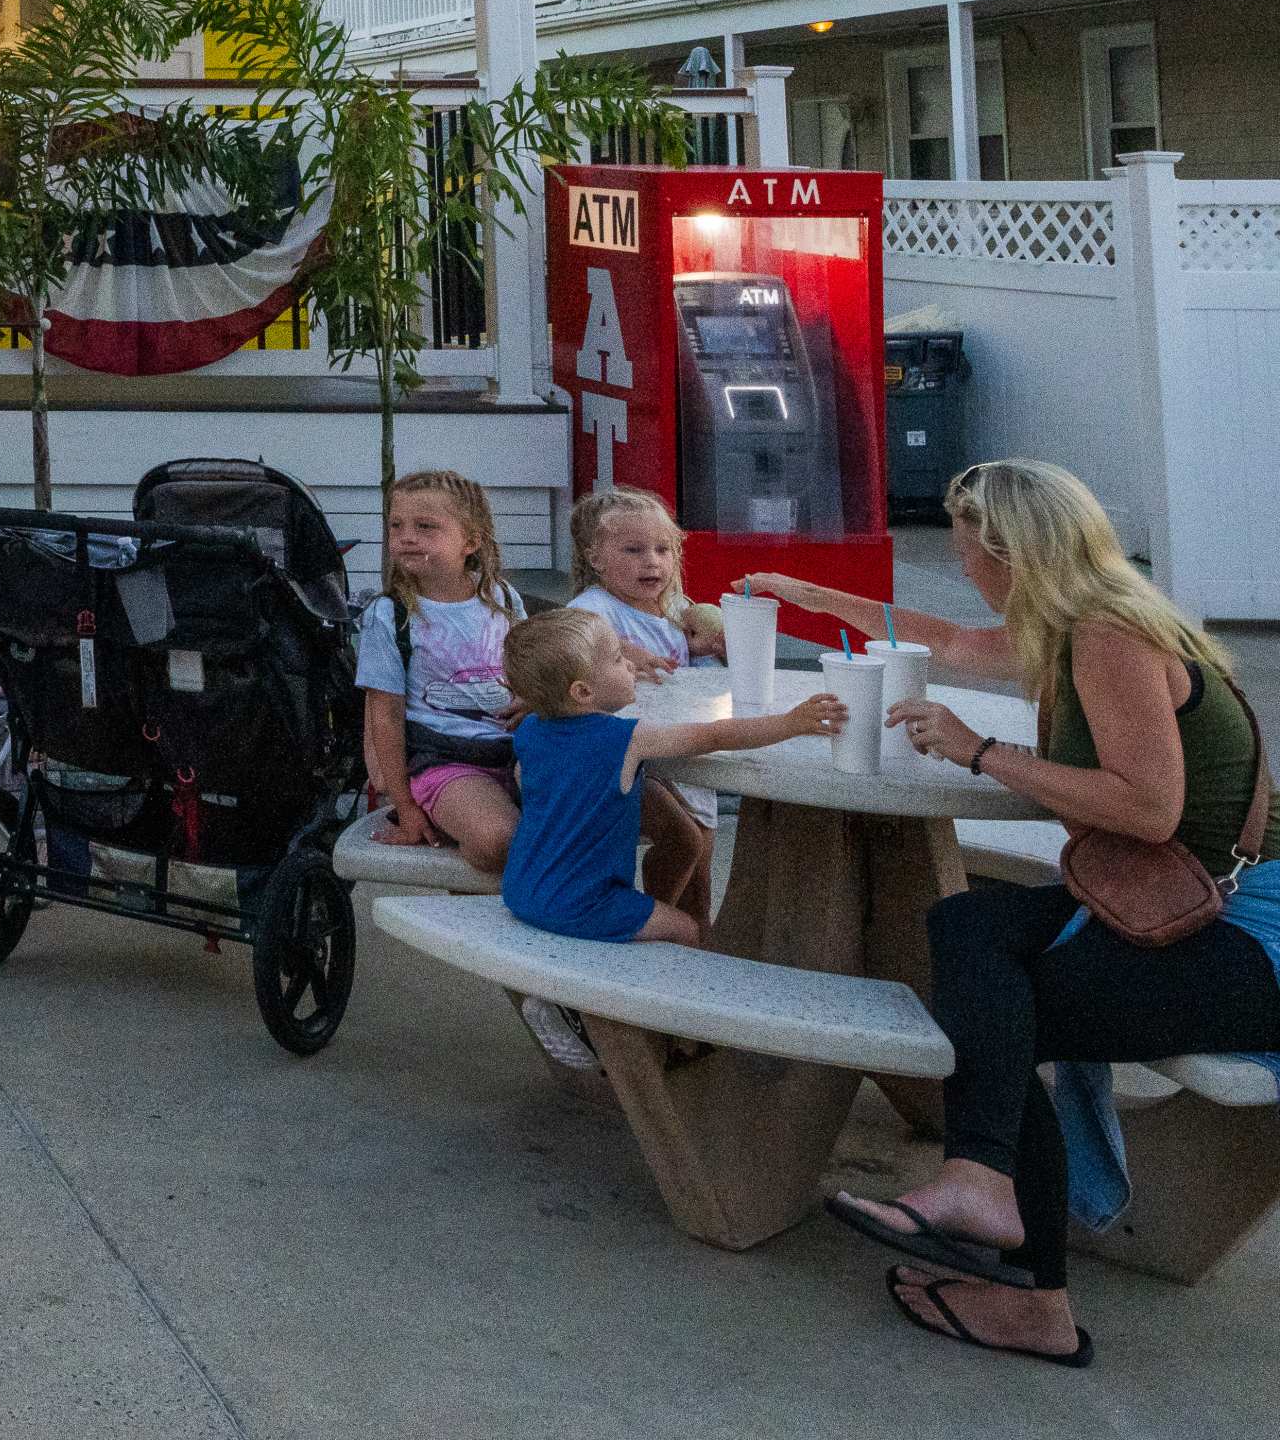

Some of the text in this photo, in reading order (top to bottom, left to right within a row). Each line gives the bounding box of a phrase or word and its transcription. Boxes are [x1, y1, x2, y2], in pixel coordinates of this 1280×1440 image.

[726, 177, 821, 205] ATM
[573, 191, 636, 248] ATM
[739, 288, 779, 305] ATM
